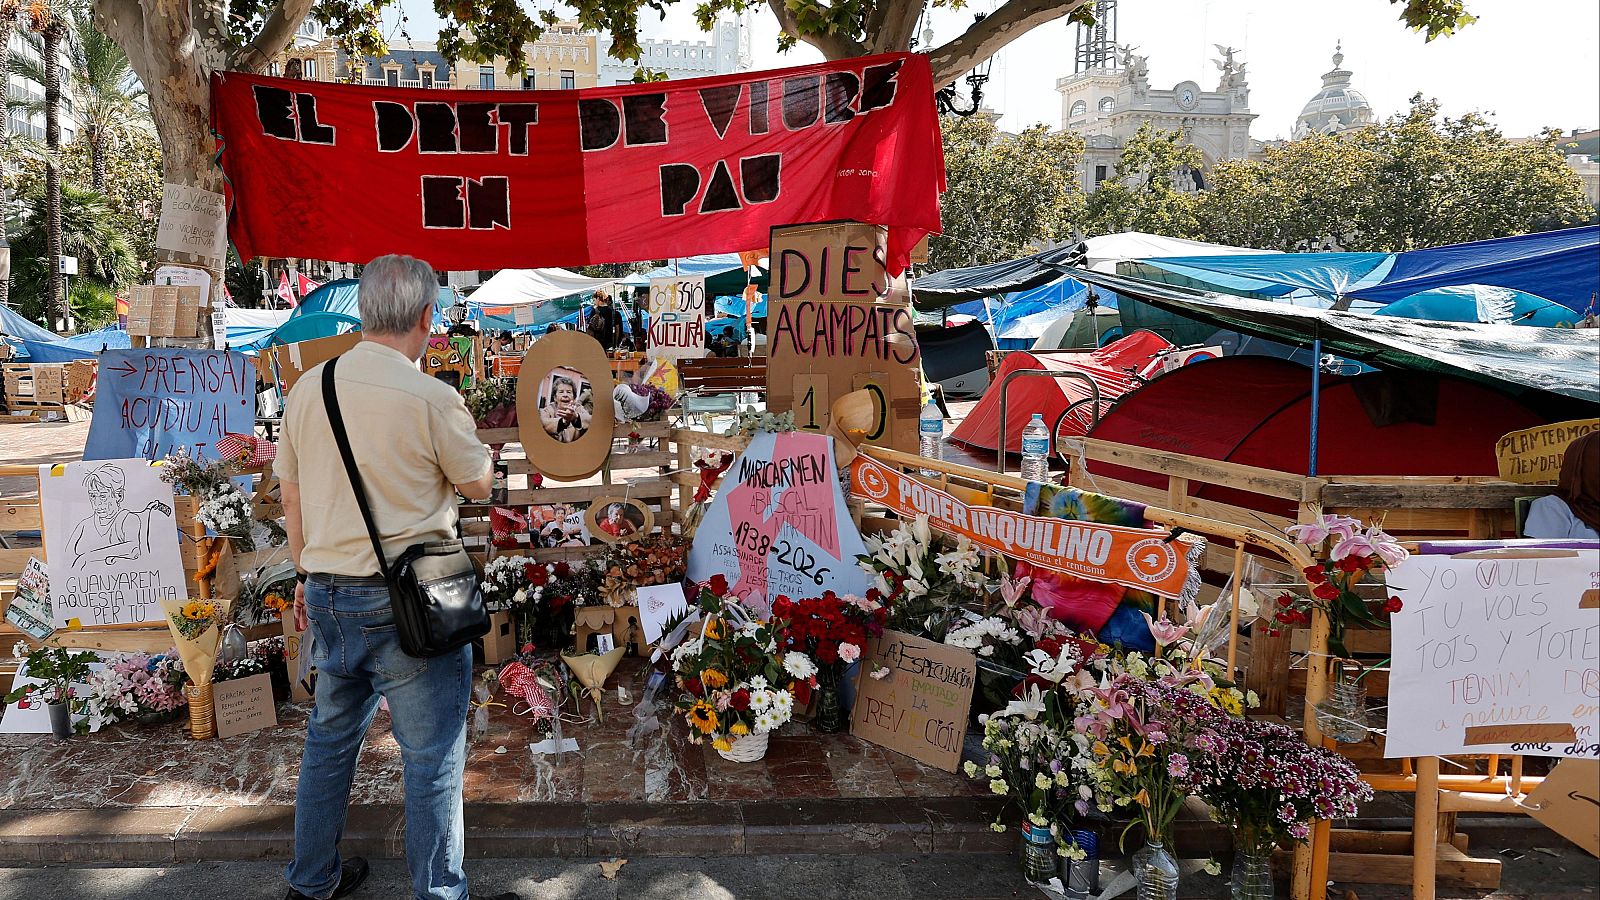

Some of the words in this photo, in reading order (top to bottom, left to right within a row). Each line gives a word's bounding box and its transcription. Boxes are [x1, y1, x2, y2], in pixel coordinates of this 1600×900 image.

[251, 83, 336, 146] EL
[372, 100, 539, 156] DRET
[577, 92, 669, 152] DE
[697, 57, 906, 141] VIURE
[420, 175, 511, 230] EN
[658, 152, 782, 217] PAU
[779, 245, 891, 299] DIES
[647, 313, 704, 350] KULTURA
[661, 312, 692, 322] DE
[771, 300, 920, 365] ACAMPATS
[140, 351, 247, 406] PRENSA!
[121, 397, 203, 433] ACUDIU
[208, 402, 240, 436] AL
[738, 453, 826, 489] MARICARMEN
[750, 487, 819, 515] ABASCAL
[898, 476, 969, 531] PODER
[970, 511, 1113, 566] INQUILINO
[1026, 551, 1052, 564] contra
[1054, 558, 1062, 566] el
[1066, 561, 1106, 576] rentismo
[57, 586, 124, 610] AQUESTA
[135, 585, 177, 606] LLUITA
[65, 569, 161, 594] GUANYAREM
[1417, 565, 1458, 604] YO
[1476, 559, 1550, 589] VULL
[93, 603, 121, 625] PER
[1413, 601, 1464, 636] TU
[1484, 592, 1549, 621] VOLS
[876, 638, 897, 662] LA
[1415, 634, 1478, 672] TOTS
[1498, 630, 1513, 664] Y
[1526, 621, 1600, 661] TOTE
[219, 690, 246, 701] GRACIAS
[911, 693, 929, 712] LA
[1446, 668, 1531, 705] TENIM
[1563, 668, 1600, 699] DR
[221, 701, 244, 710] REMOVER
[246, 711, 262, 719] GENTE
[1434, 718, 1449, 732] a
[1510, 738, 1553, 752] amb
[1564, 738, 1600, 757] dig
